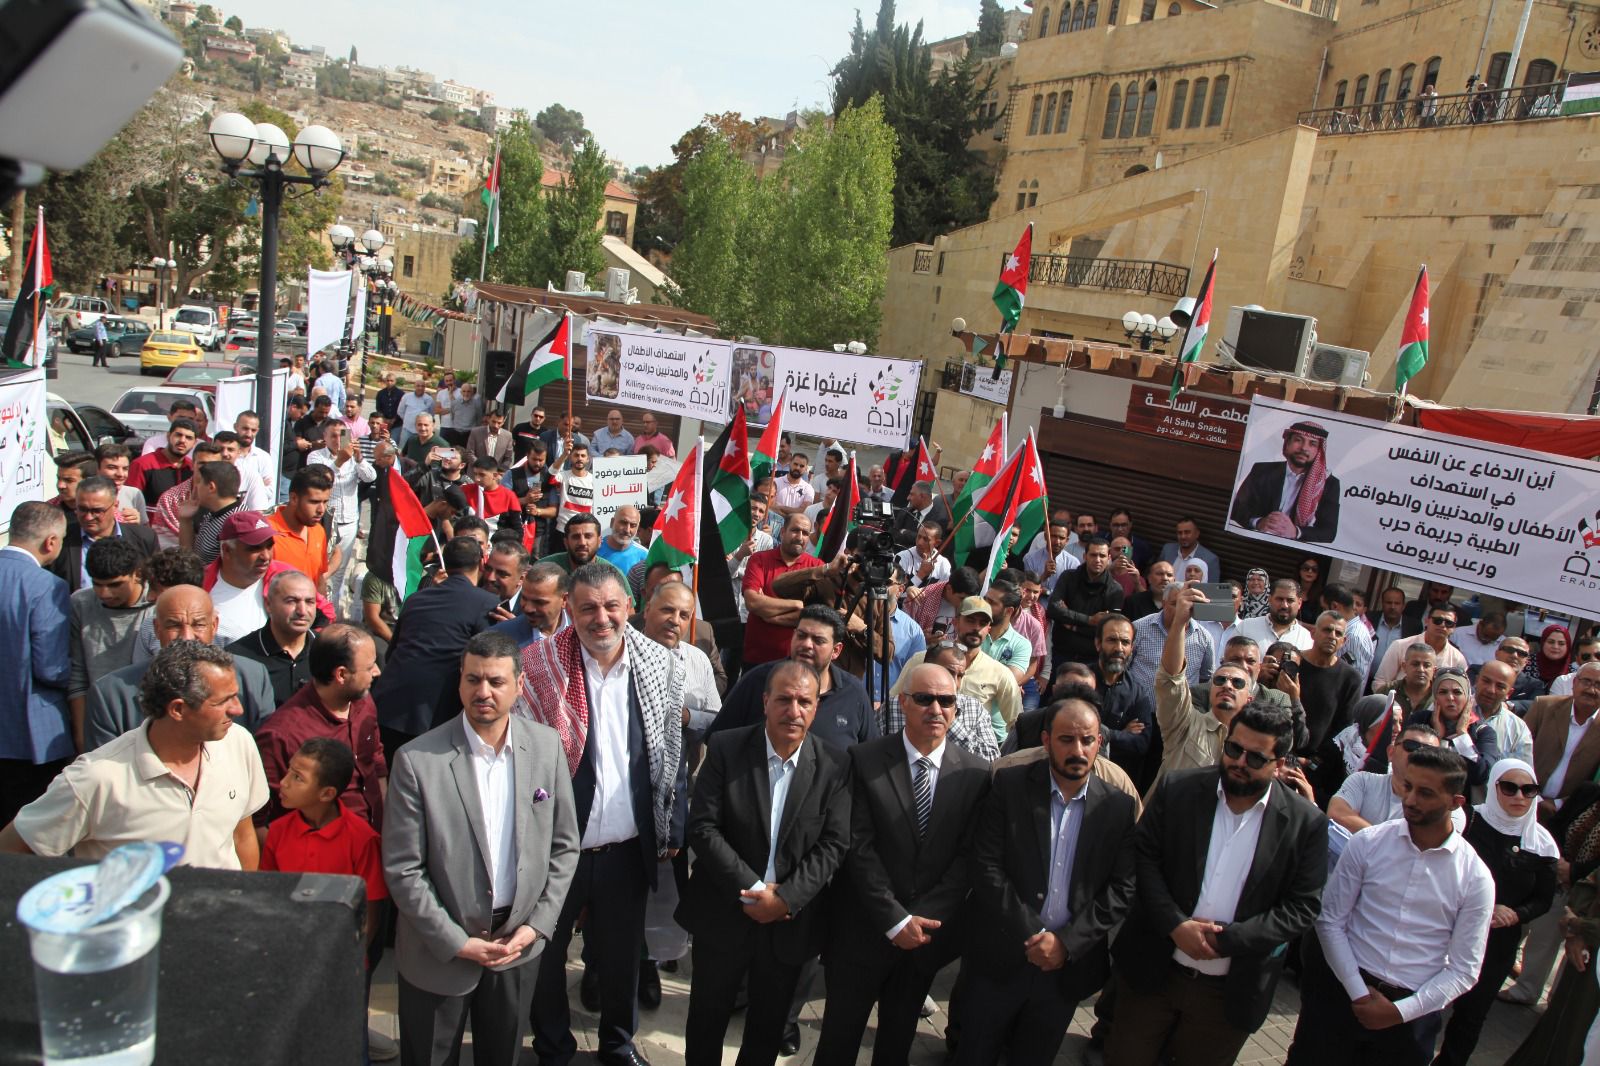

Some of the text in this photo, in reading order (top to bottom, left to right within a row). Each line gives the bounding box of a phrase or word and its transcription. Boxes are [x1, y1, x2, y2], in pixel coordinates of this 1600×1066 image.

[656, 364, 688, 380] والمدنيين
[625, 378, 646, 390] Killing
[670, 388, 684, 396] and
[786, 370, 857, 398] أغيثوا غزة
[620, 390, 646, 401] children
[652, 397, 664, 405] war
[664, 398, 686, 409] crimes
[1145, 393, 1248, 424] مطعم الساحة
[789, 400, 848, 420] Help Gaza
[1163, 416, 1227, 435] Al Saha Snacks
[595, 468, 622, 479] بوضوح
[1388, 448, 1556, 491] أين الدفاع عن النفس
[602, 482, 642, 497] التنازل
[1410, 474, 1516, 510] في استهداف
[1344, 485, 1576, 544] الأطفال والمدنيين والطواقم
[1379, 516, 1520, 556] الطبية جريمة حرب
[1452, 558, 1497, 578] ورعب
[1560, 574, 1600, 590] ERAD
